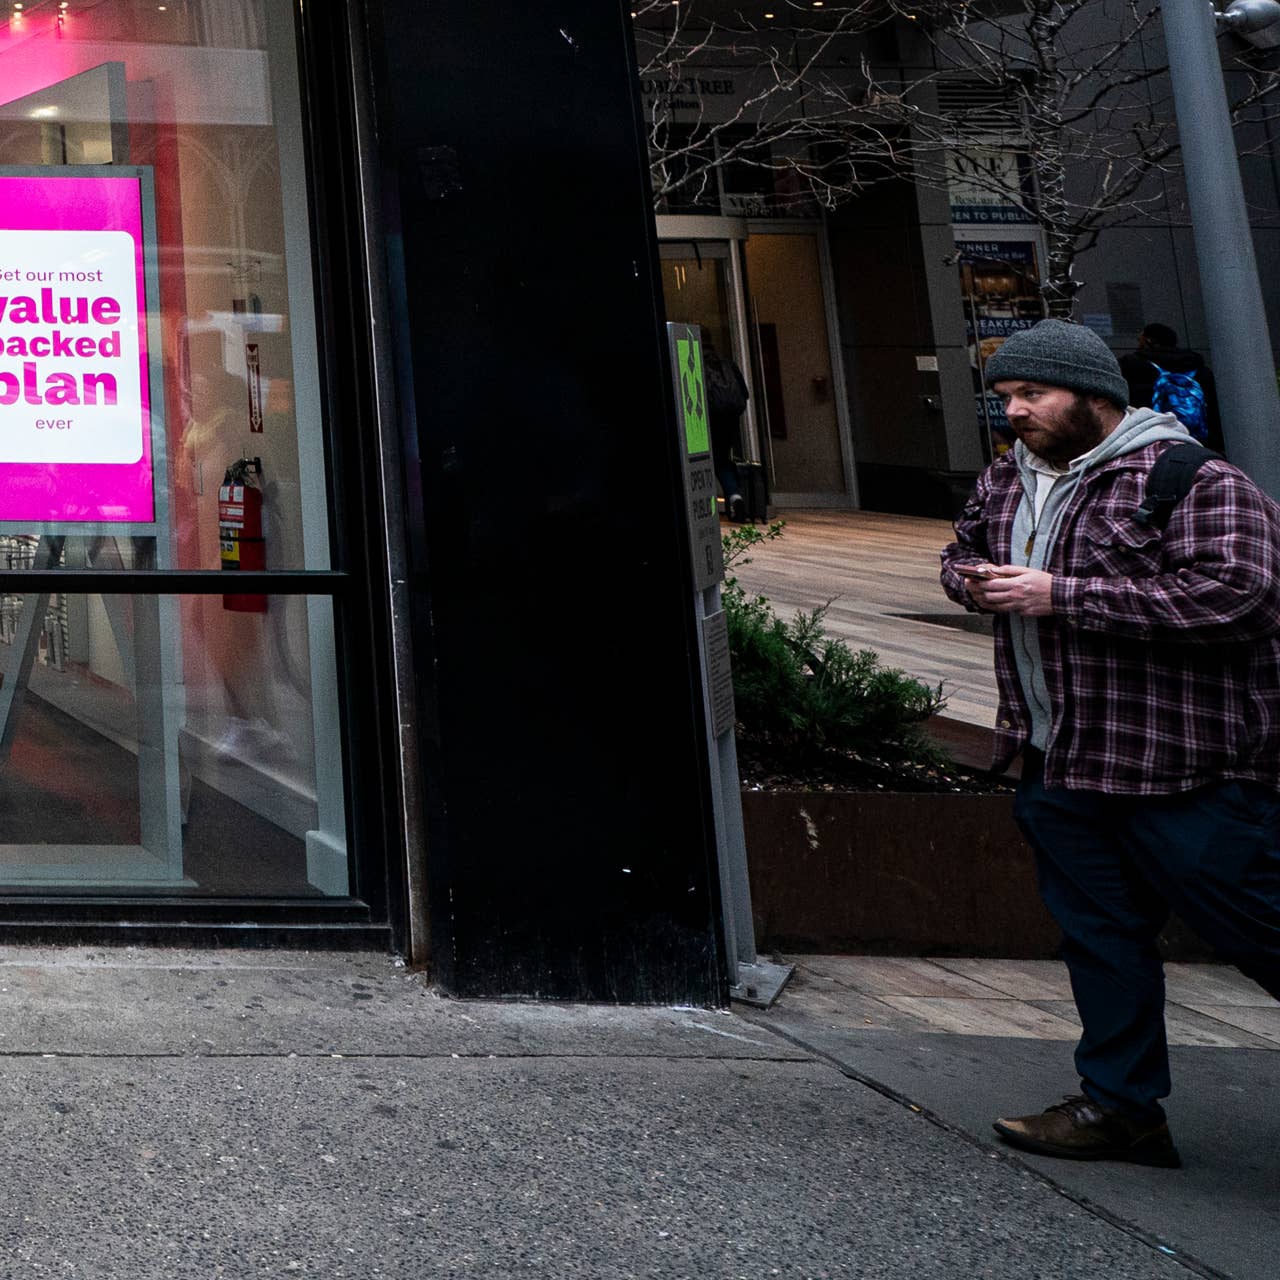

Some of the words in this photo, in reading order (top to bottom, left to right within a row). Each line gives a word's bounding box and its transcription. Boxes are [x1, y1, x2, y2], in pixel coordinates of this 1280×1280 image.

[26, 271, 55, 282] our
[60, 269, 103, 284] most
[35, 418, 74, 430] ever
